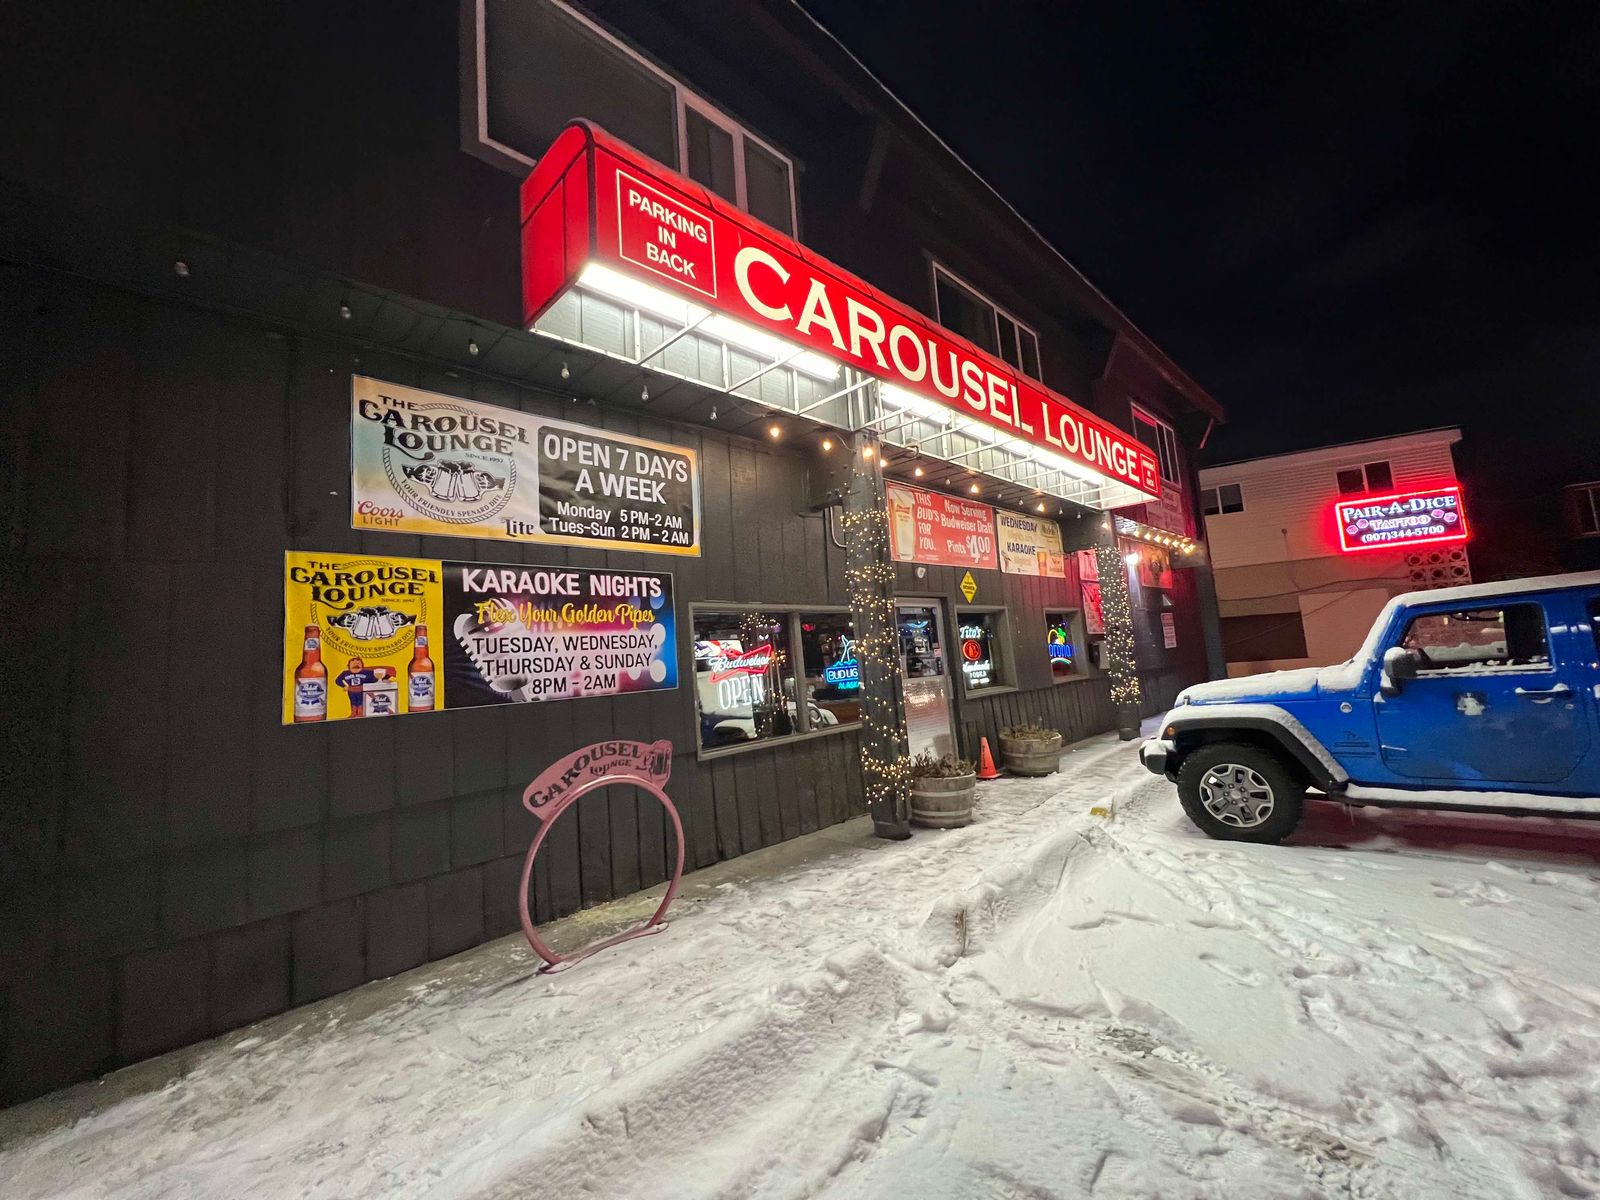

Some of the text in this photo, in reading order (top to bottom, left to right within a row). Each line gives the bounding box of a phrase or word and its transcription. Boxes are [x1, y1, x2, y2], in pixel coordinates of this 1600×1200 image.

[629, 188, 708, 244] PARKING
[658, 226, 676, 249] IN
[646, 242, 696, 280] BACK
[734, 246, 1140, 484] CAROUSEL LOUNGE
[378, 394, 418, 411] THE
[358, 398, 530, 445] CAROUSEL
[383, 424, 513, 461] LOUNGE
[544, 434, 688, 482] OPEN 7 DAYS
[574, 468, 667, 504] A WEEK
[401, 480, 418, 500] YOUR
[420, 498, 455, 516] FRIENDLY
[457, 506, 489, 517] SPENARD
[914, 492, 932, 506] THIS
[358, 500, 404, 519] Coors
[557, 500, 612, 524] Monday
[620, 510, 628, 522] 5
[664, 516, 682, 530] AM
[917, 507, 940, 522] BUD'S
[944, 500, 987, 521] Now Serving
[1342, 496, 1457, 523] PAIR-A-DICE
[363, 516, 400, 527] LIGHT
[502, 516, 534, 538] Lite
[549, 517, 616, 538] Tues-Sun
[621, 526, 629, 538] 2
[632, 526, 650, 540] PM
[662, 530, 669, 542] 2
[670, 531, 689, 544] AM
[918, 522, 932, 535] FOR
[940, 513, 976, 531] Budweiser
[1001, 516, 1038, 532] WEDNESDAY
[1369, 514, 1431, 531] TATTOO
[920, 537, 936, 550] YOU.
[1361, 525, 1444, 543] (907)344-5700
[947, 540, 966, 554] Pints
[1007, 542, 1036, 555] KARAOKE
[308, 560, 342, 570] THE
[290, 566, 439, 586] CAROUSEL
[462, 568, 662, 598] KARAOKE NIGHTS
[312, 581, 424, 610] LOUNGE
[474, 598, 655, 630] Flex Your Golden Pipes
[960, 625, 981, 638] Tito's
[472, 634, 658, 655] TUESDAY, WEDNESDAY,
[482, 653, 652, 676] THURSDAY & SUNDAY
[708, 654, 770, 672] Budweiser
[532, 677, 566, 694] 8PM
[584, 674, 616, 690] 2AM
[828, 668, 858, 680] BUD LIG
[719, 673, 764, 710] OPEN
[838, 681, 858, 689] ALASK
[529, 742, 641, 808] CAROUSEL
[590, 758, 632, 776] LOUNGE
